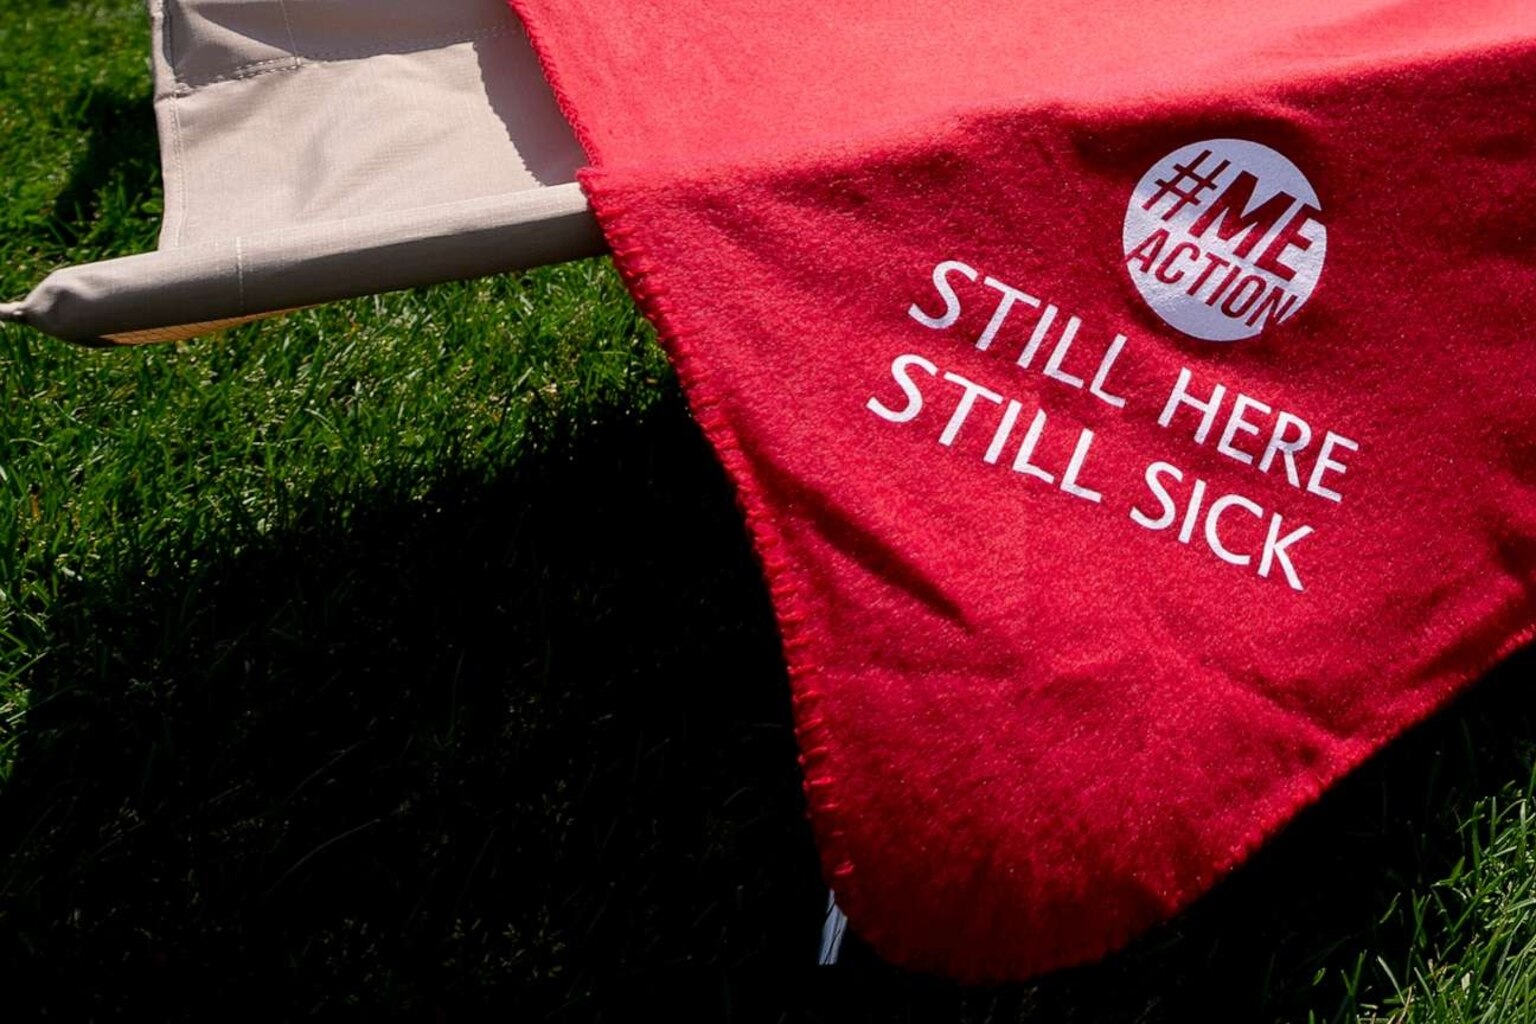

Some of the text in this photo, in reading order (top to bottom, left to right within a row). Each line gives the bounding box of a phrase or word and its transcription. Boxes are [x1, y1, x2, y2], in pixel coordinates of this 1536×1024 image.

[1125, 229, 1297, 330] ACTION
[1141, 149, 1328, 280] #ME
[866, 353, 1316, 592] STILL SICK
[907, 260, 1360, 503] STILL HERE
